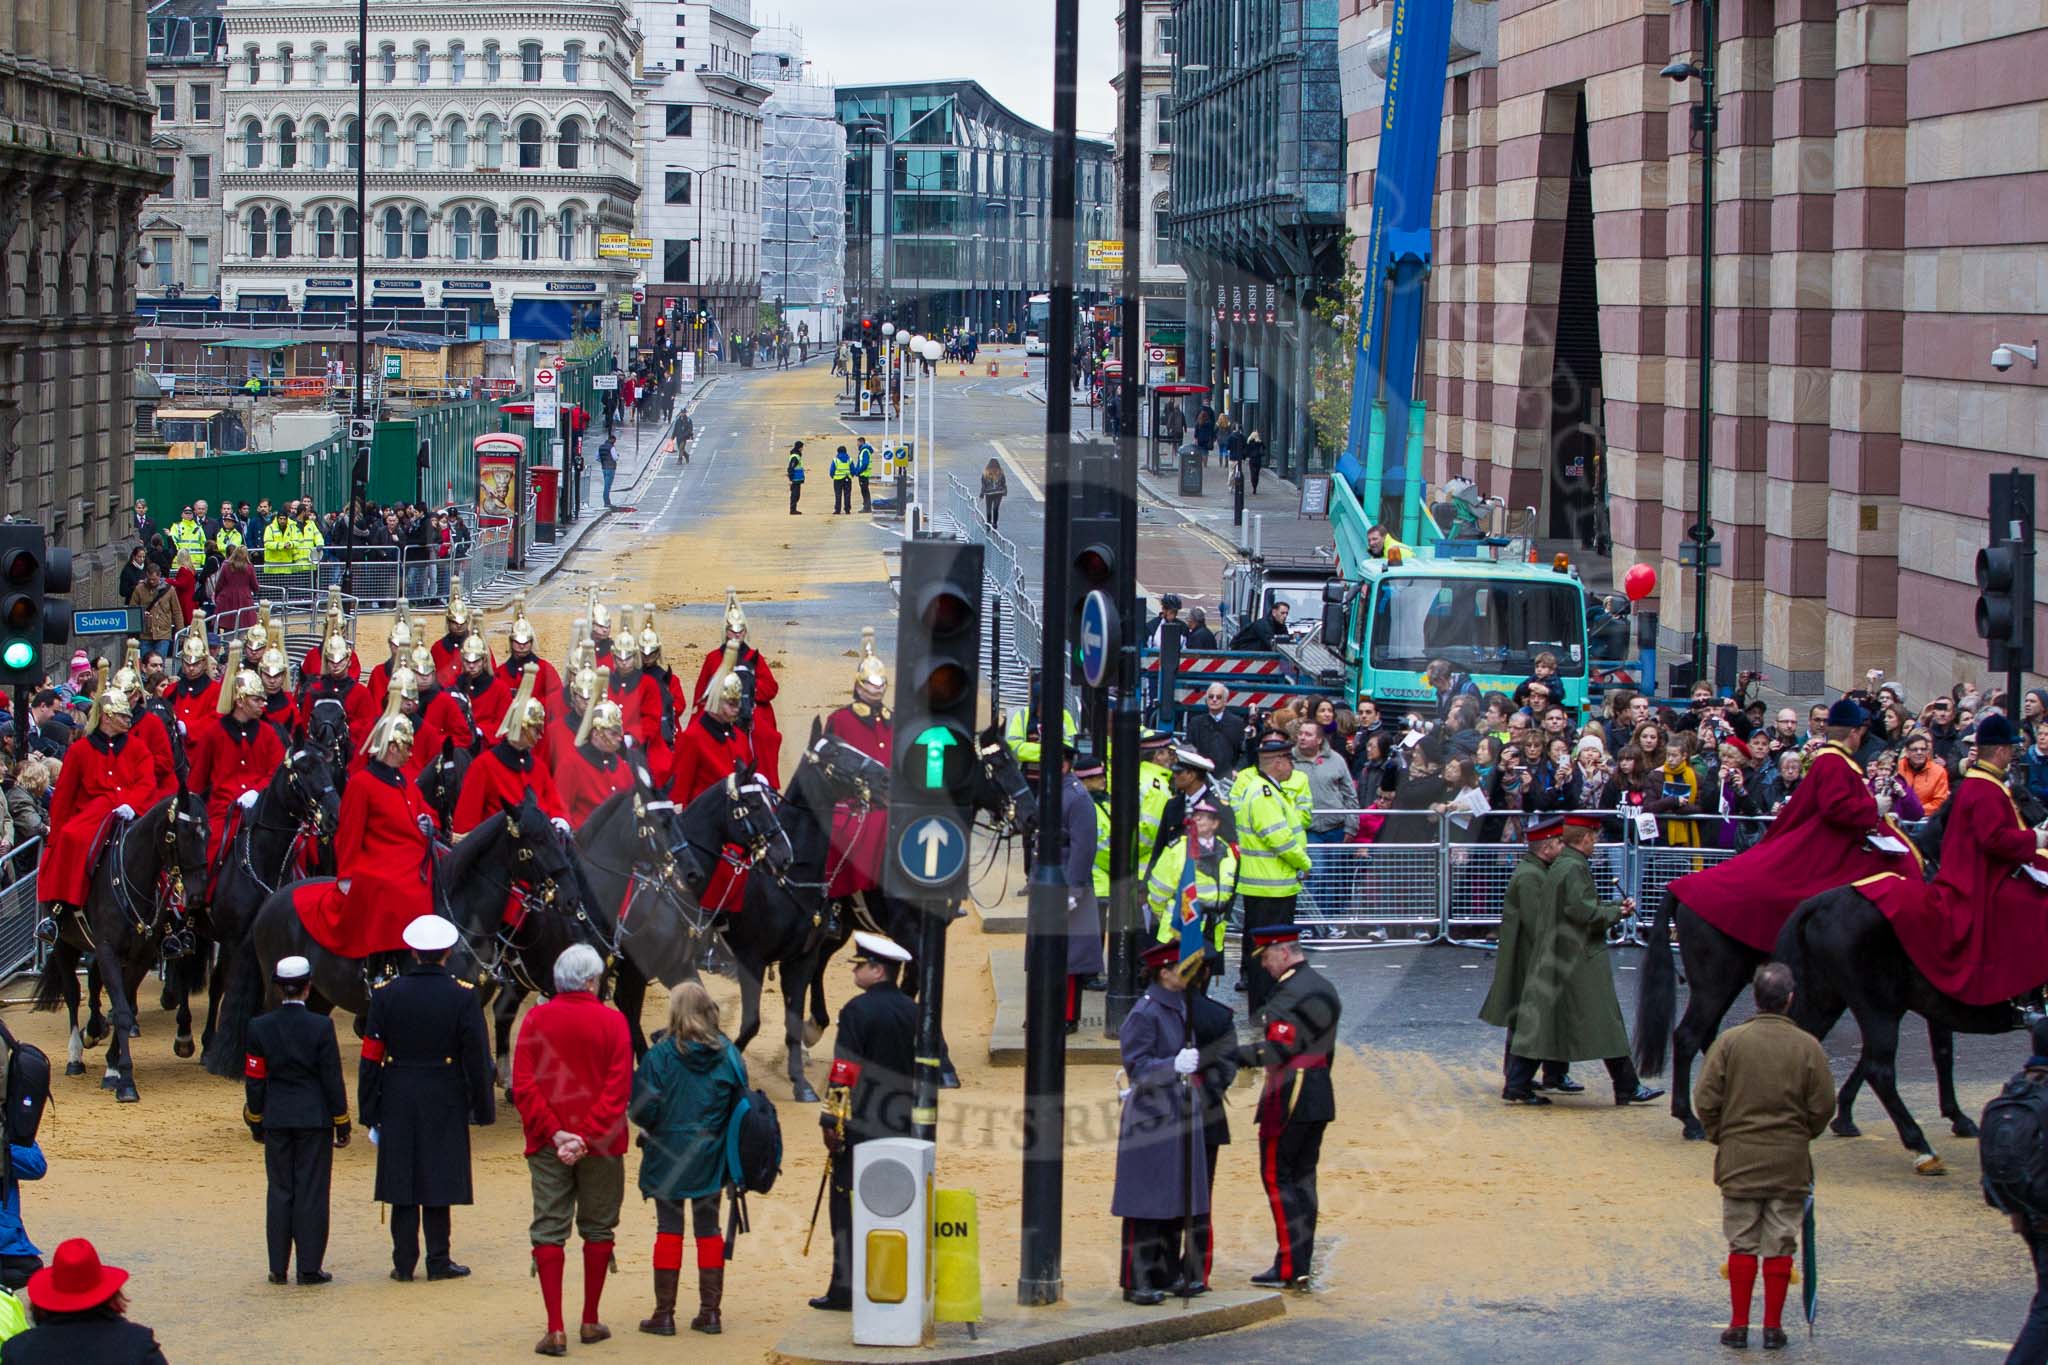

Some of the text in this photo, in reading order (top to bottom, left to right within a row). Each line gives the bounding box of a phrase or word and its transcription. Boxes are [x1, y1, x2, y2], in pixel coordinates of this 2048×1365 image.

[1385, 96, 1396, 129] for
[602, 238, 626, 247] TO RENT
[1218, 285, 1226, 308] HSBC
[1233, 286, 1241, 311] HSBC
[1248, 285, 1257, 310] HSBC
[1265, 284, 1275, 310] HSBC
[81, 616, 121, 627] Subway
[1381, 687, 1432, 698] VOLVO
